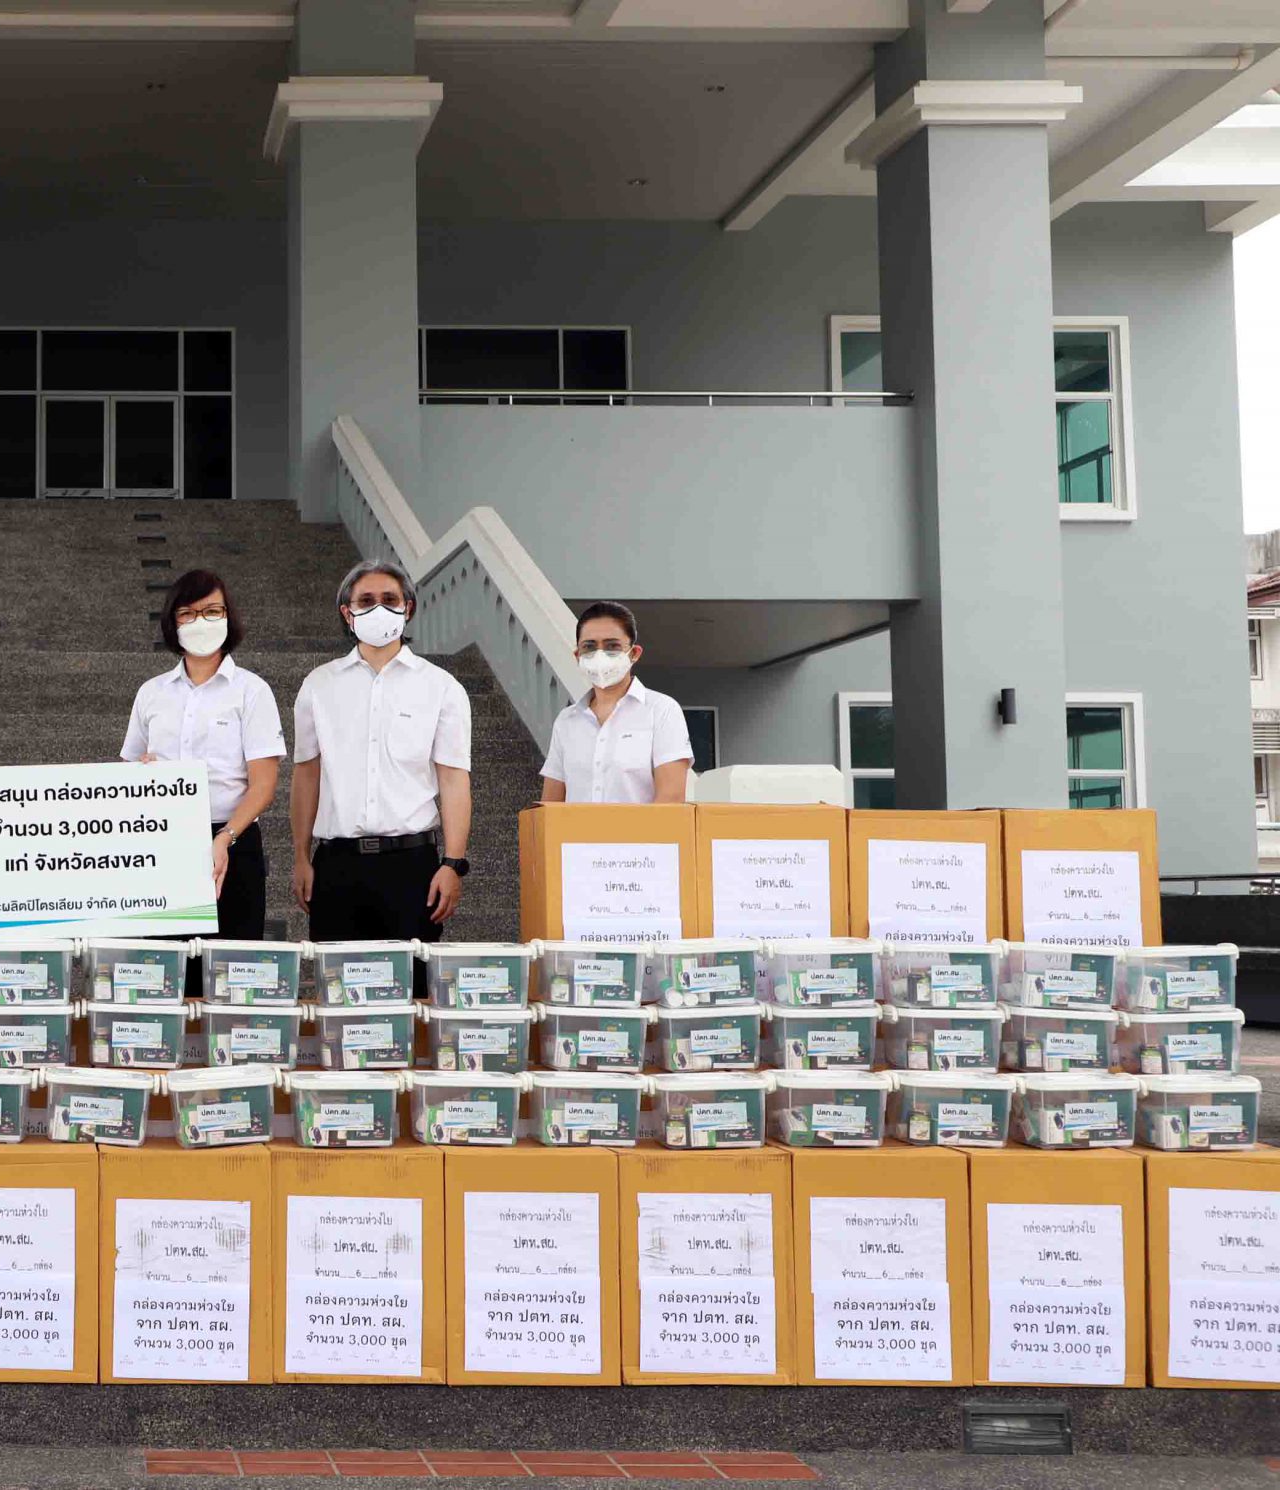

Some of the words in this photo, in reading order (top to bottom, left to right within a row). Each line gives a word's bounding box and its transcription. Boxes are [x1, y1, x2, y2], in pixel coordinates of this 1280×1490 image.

[43, 776, 198, 802] กล่องความห่วงใย
[58, 818, 114, 839] 3,000
[118, 813, 169, 834] กล่อง
[4, 852, 29, 873] แก่
[33, 851, 157, 872] จังหวัดสงขลา
[85, 896, 118, 910] จำกัด
[119, 895, 167, 912] (มหาชน)
[132, 1296, 235, 1313] กล่องความห่วงใย
[305, 1291, 408, 1309] กล่องความห่วงใย
[483, 1288, 586, 1305] กล่องความห่วงใย
[658, 1289, 761, 1305] กล่องความห่วงใย
[832, 1296, 936, 1312] กล่องความห่วงใย
[1189, 1296, 1280, 1314] กล่องความห่วง
[34, 1310, 58, 1322] สผ.
[487, 1310, 513, 1323] จาก
[518, 1308, 555, 1324] ปตท.
[559, 1313, 584, 1325] สผ.
[1009, 1300, 1112, 1316] กล่องความห่วงใย
[136, 1318, 162, 1330] จาก
[167, 1316, 204, 1332] ปตท.
[208, 1320, 233, 1332] สผ.
[308, 1313, 335, 1326] จาก
[339, 1312, 377, 1327] ปตท.
[381, 1316, 406, 1329] สผ.
[661, 1311, 688, 1324] จาก
[692, 1309, 729, 1325] ปตท.
[734, 1313, 759, 1325] สผ.
[836, 1319, 864, 1331] จาก
[868, 1316, 905, 1331] ปตท.
[910, 1319, 934, 1332] สผ.
[1192, 1318, 1220, 1331] จาก
[1224, 1317, 1262, 1333] ปตท.
[1012, 1322, 1039, 1334] จาก
[1043, 1320, 1081, 1335] ปตท.
[1085, 1324, 1110, 1336] สผ.
[43, 1330, 60, 1345] ชุด
[133, 1335, 172, 1350] จำนวน
[217, 1341, 235, 1355] ชุด
[305, 1330, 345, 1345] จำนวน
[390, 1336, 407, 1351] ชุด
[484, 1327, 523, 1342] จำนวน
[569, 1333, 586, 1348] ชุด
[659, 1328, 697, 1343] จำนวน
[743, 1334, 761, 1349] ชุด
[834, 1335, 874, 1350] จำนวน
[920, 1340, 937, 1354] ชุด
[1190, 1335, 1229, 1350] จำนวน
[1010, 1339, 1049, 1353] จำนวน
[1095, 1345, 1112, 1359] ชุด
